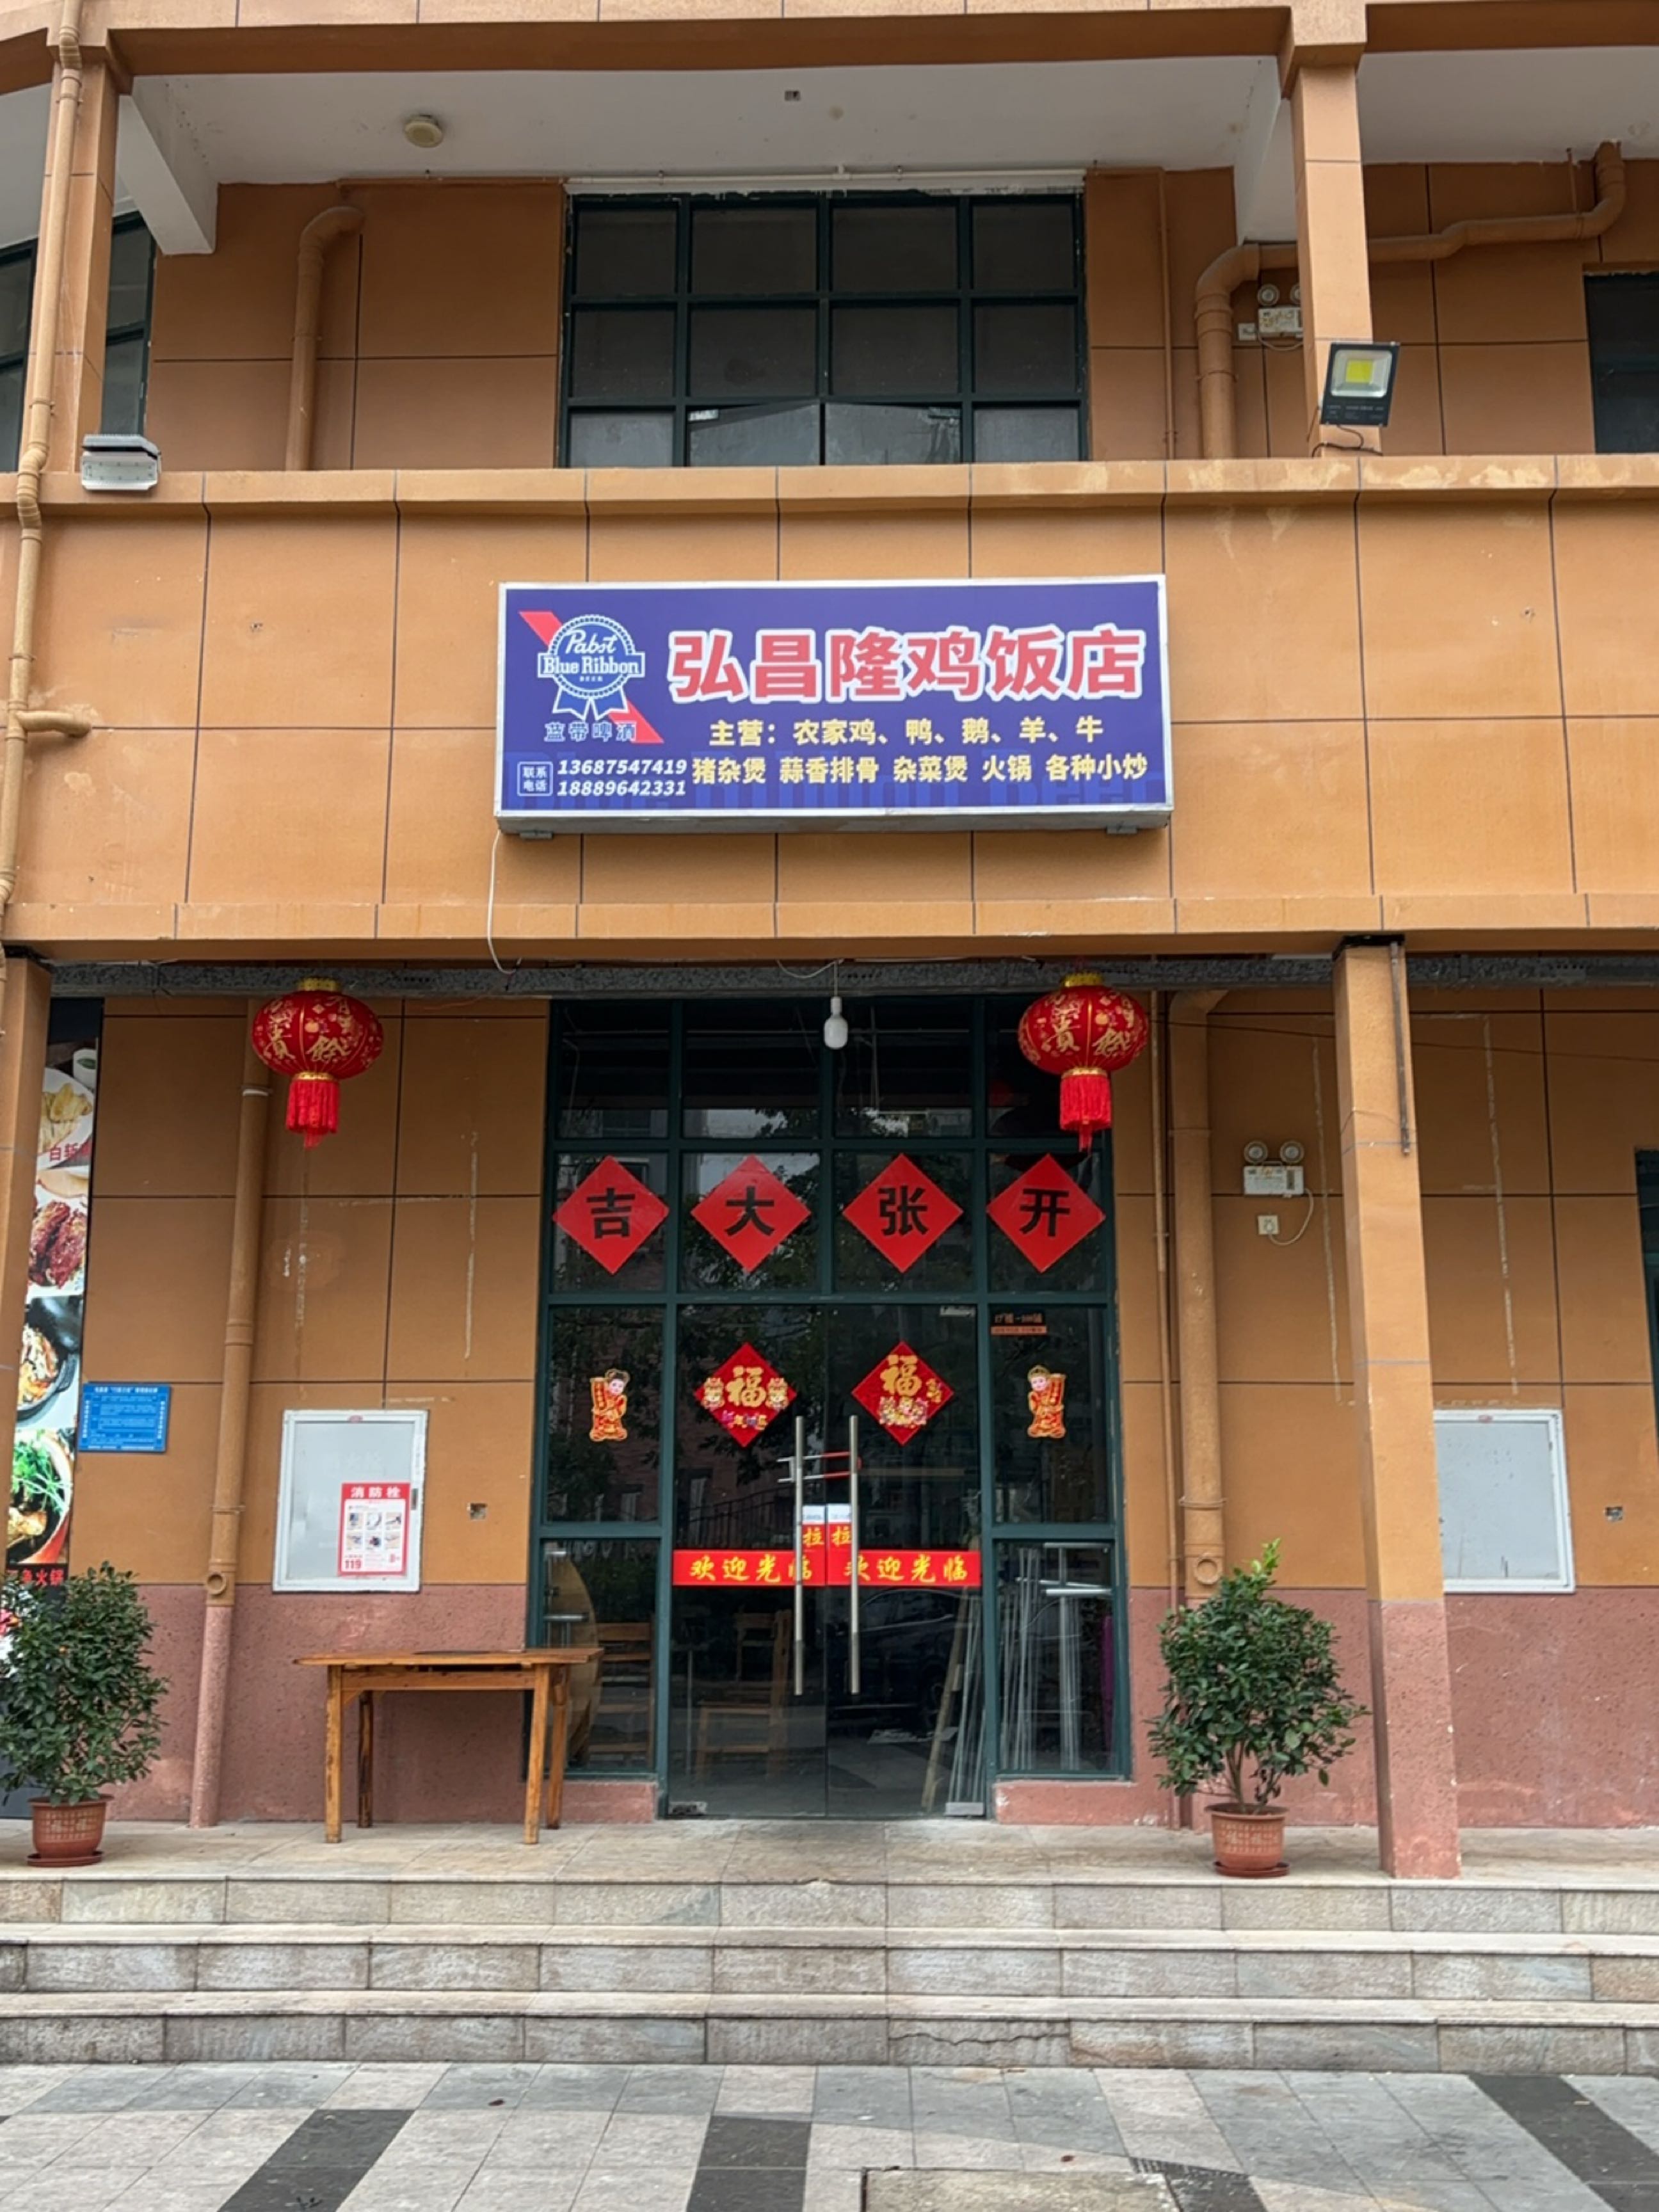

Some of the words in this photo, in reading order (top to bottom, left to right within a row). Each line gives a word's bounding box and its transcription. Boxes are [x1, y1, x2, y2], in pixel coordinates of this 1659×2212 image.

[566, 629, 619, 655] Pabst
[543, 655, 579, 675] Blue
[581, 656, 640, 676] Ribbon
[667, 623, 1146, 704] 弘昌隆鸡饭店
[557, 759, 687, 775] 13687547419
[693, 757, 766, 785] 猪杂煲
[780, 756, 879, 785] 蒜香排骨
[893, 755, 968, 783] 杂菜煲
[982, 755, 1032, 782] 火锅
[1046, 753, 1148, 782] 各种小炒
[557, 780, 687, 797] 18889642331
[586, 1187, 636, 1239] 吉
[725, 1185, 775, 1237] 大
[878, 1187, 929, 1237] 张
[1020, 1188, 1071, 1238] 开
[726, 1365, 767, 1407] 福
[880, 1354, 922, 1397] 福
[802, 1527, 824, 1548] 拉
[831, 1525, 852, 1547] 拉
[344, 1558, 362, 1569] 119
[689, 1553, 812, 1583] 欢迎光临
